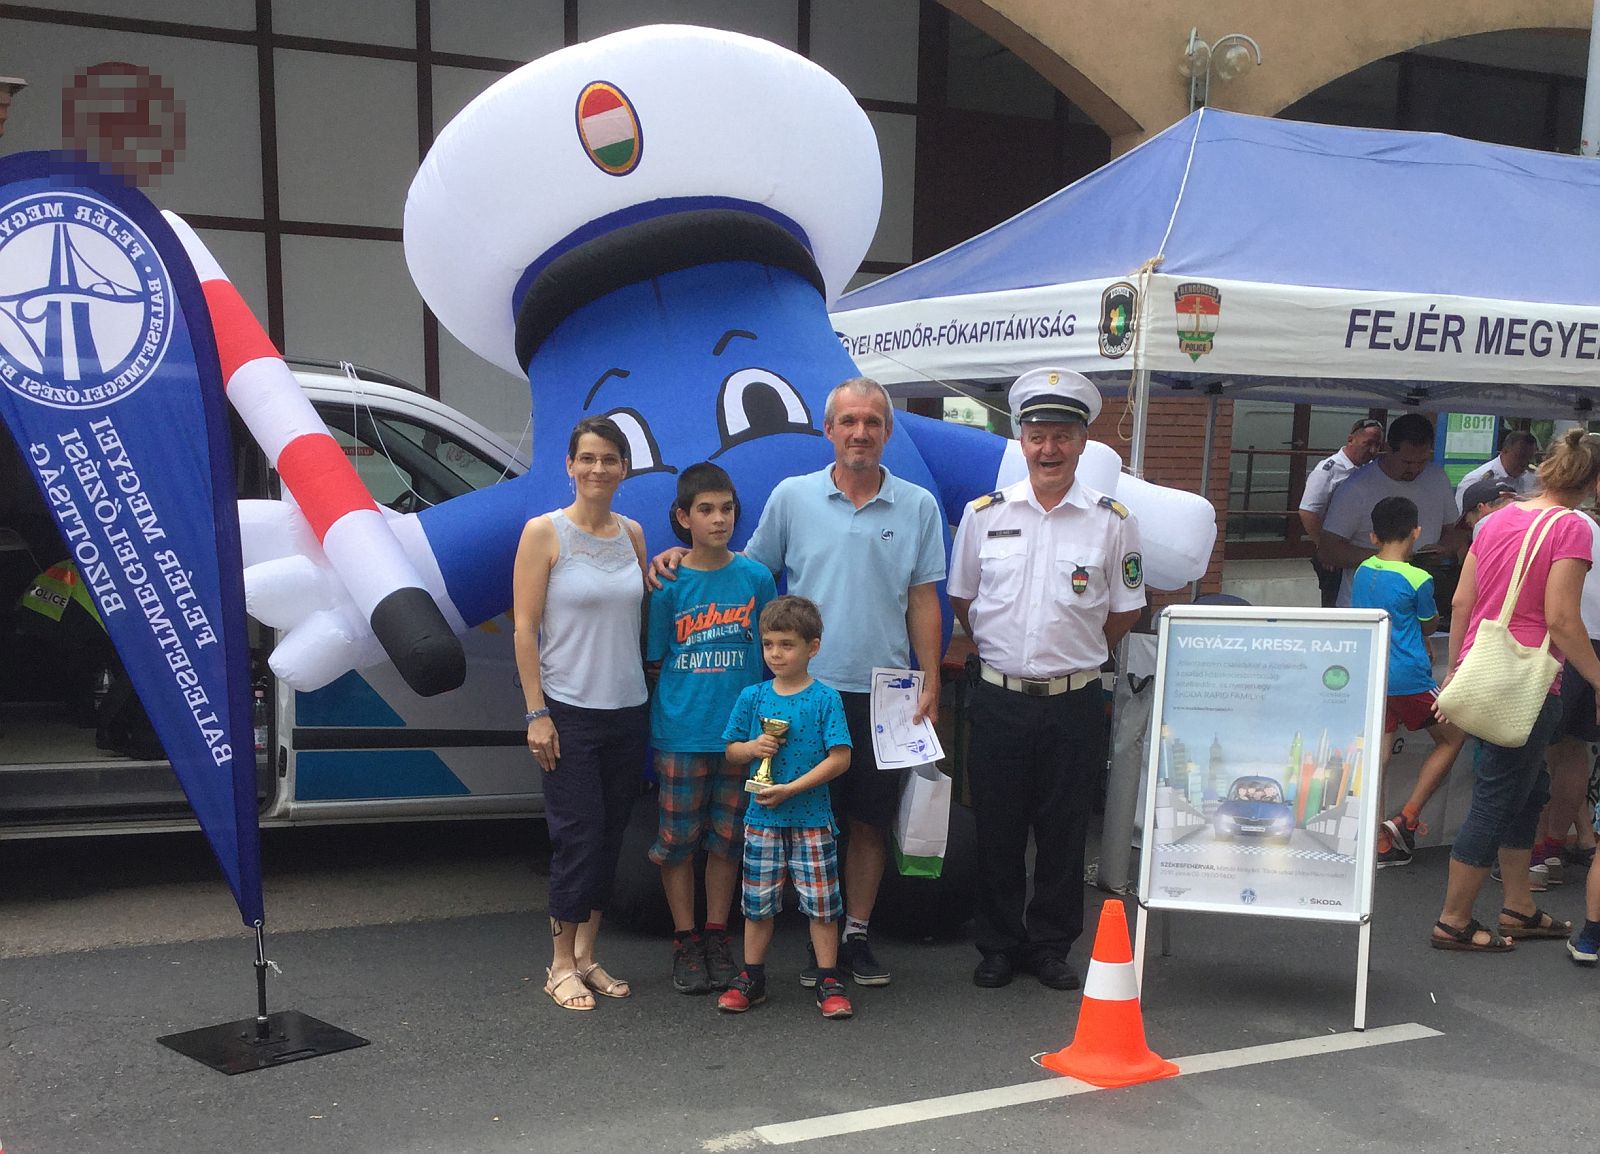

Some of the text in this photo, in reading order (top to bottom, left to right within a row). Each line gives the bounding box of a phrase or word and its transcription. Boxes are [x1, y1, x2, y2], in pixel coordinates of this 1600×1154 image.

[874, 310, 1077, 352] RENDŐR-FŐKAPITÁNYSÁG
[1345, 304, 1600, 360] FEJÉR MEGYE
[1184, 343, 1207, 353] POLICE
[1463, 415, 1494, 430] 8011
[1177, 635, 1358, 653] VIGYÁZZ, KRESZ, RAJT!
[674, 651, 745, 669] HEAVY DUTY
[1309, 897, 1343, 907] ŠKODA
